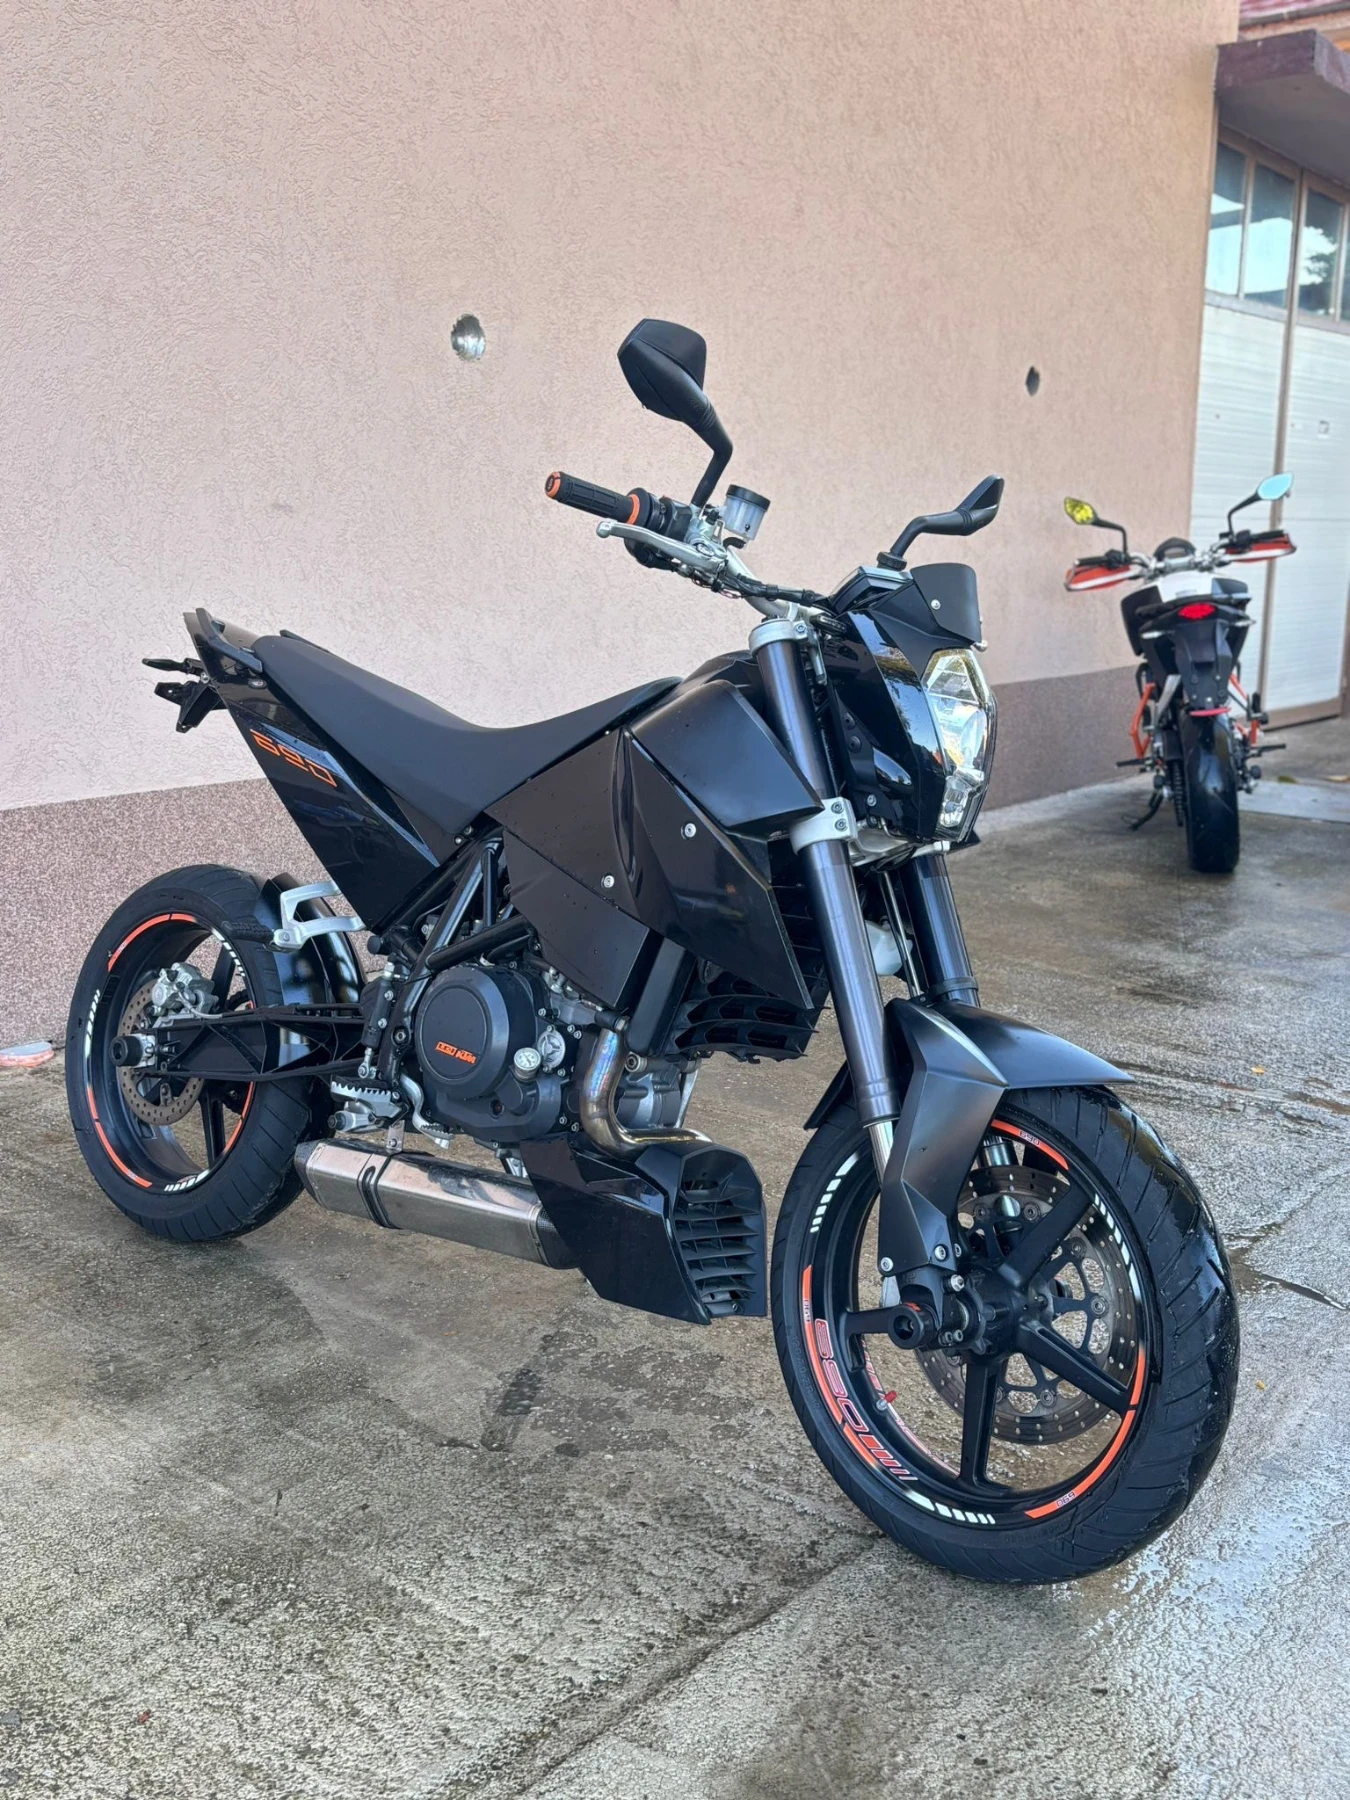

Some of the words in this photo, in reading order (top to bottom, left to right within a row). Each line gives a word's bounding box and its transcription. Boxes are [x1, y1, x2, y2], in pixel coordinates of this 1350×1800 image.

[249, 729, 337, 787] 690
[456, 1050, 476, 1064] KTM
[815, 1318, 869, 1432] 690
